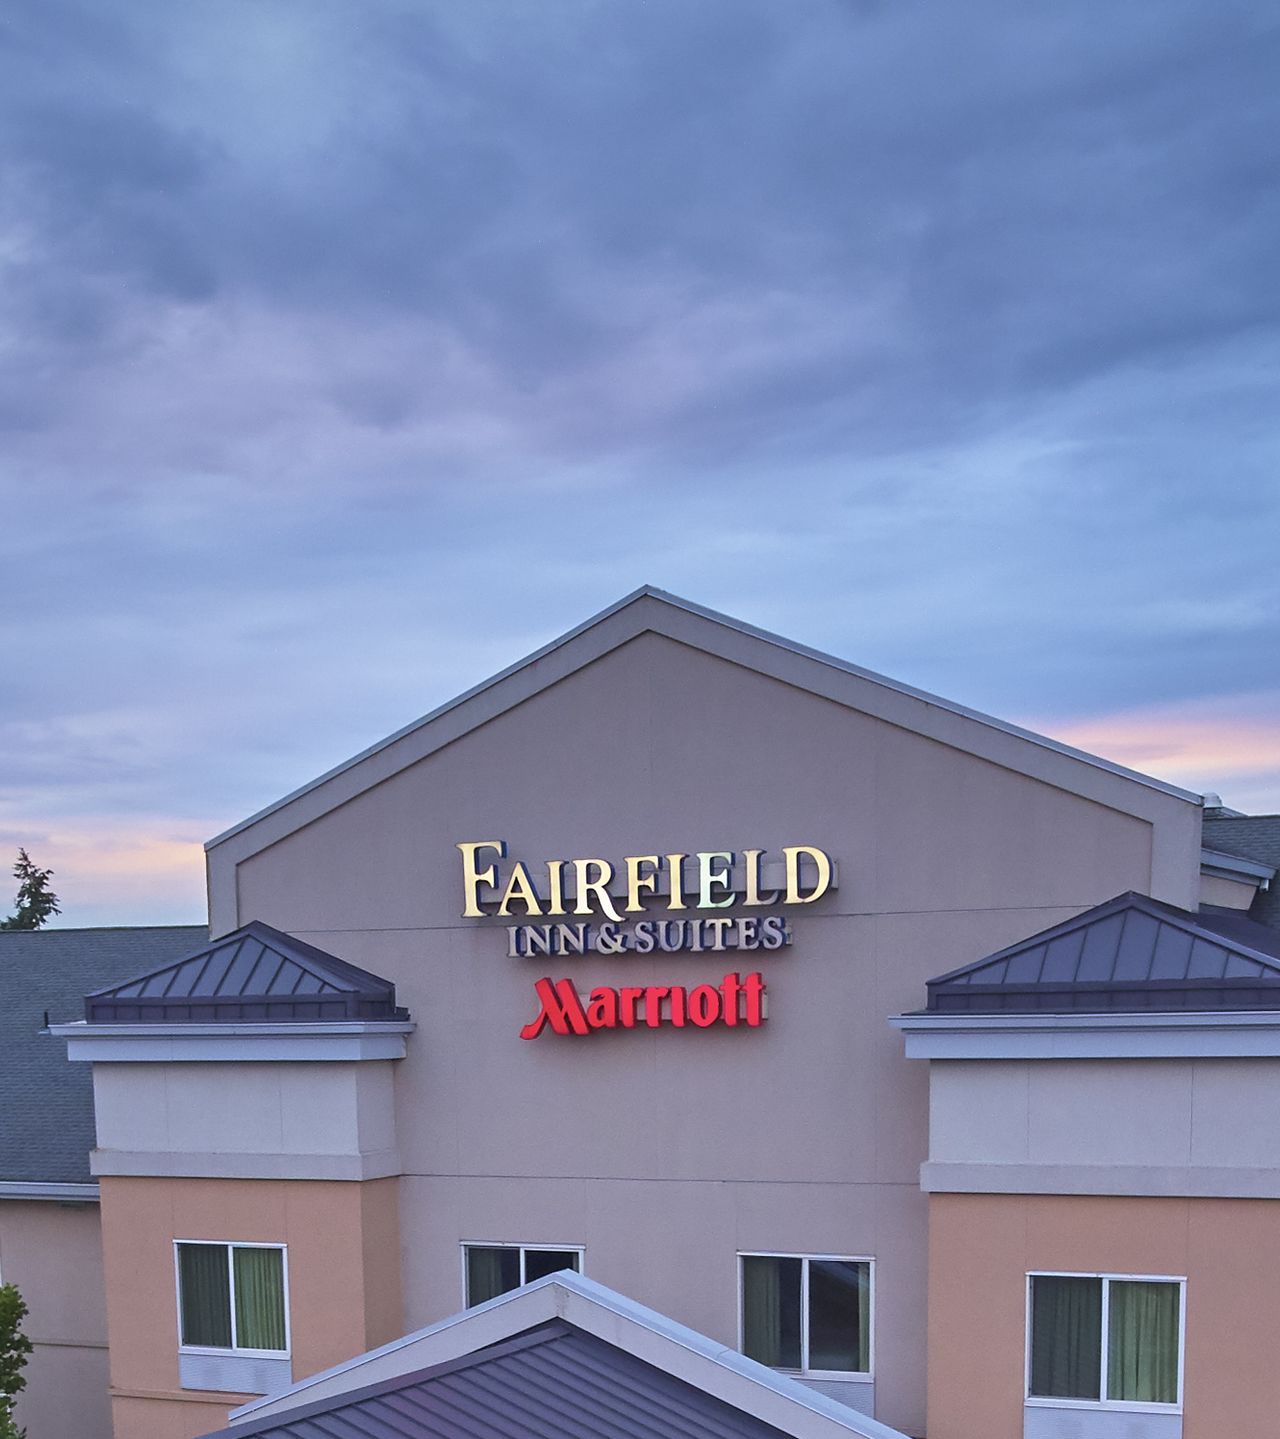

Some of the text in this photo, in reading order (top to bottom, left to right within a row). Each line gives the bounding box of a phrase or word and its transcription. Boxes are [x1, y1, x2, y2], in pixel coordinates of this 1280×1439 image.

[455, 839, 832, 921] FAIRFIELD
[507, 922, 587, 958] INN
[634, 916, 787, 954] SUITES
[519, 971, 767, 1041] Marriott
